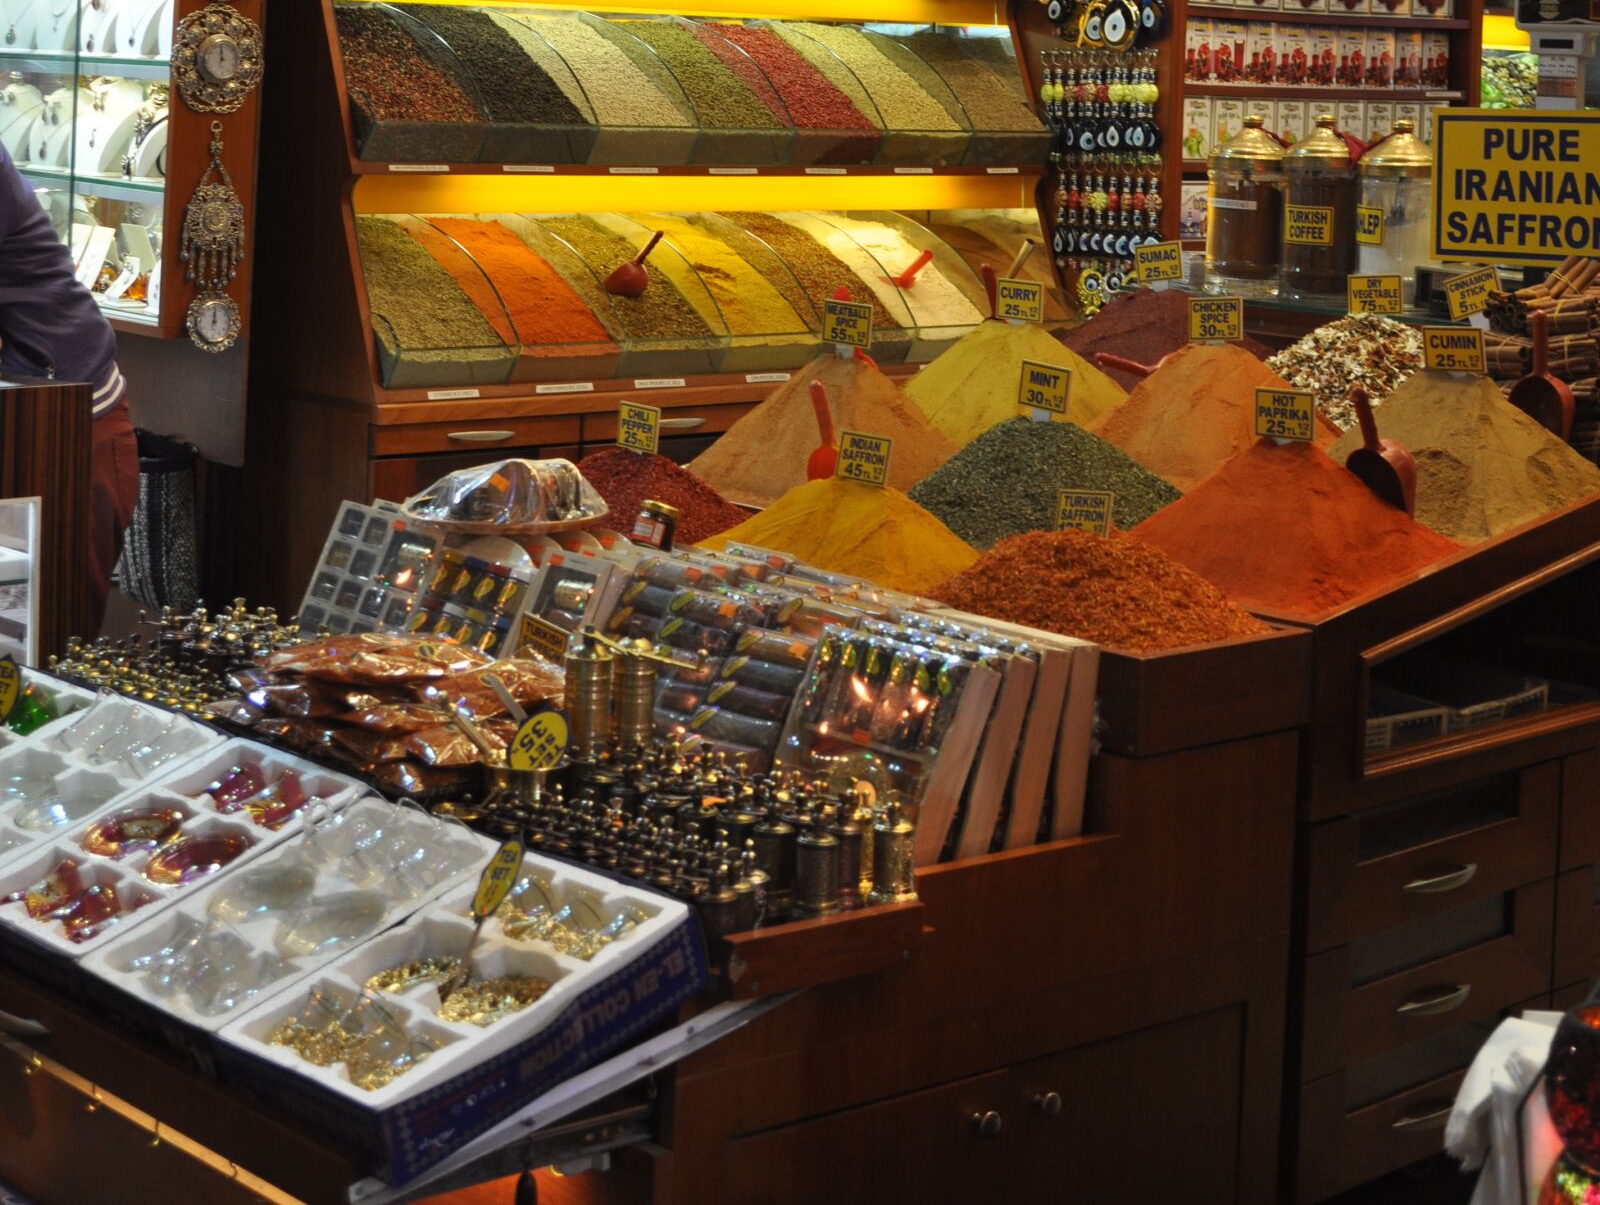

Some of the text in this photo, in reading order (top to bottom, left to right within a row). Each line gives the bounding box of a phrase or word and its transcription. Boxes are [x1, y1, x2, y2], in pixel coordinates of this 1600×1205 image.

[1483, 128, 1580, 162] PURE
[1288, 209, 1328, 225] TURKISH
[1289, 224, 1325, 240] COFFEE
[1139, 249, 1177, 264] SUMAC
[1367, 279, 1382, 288] DRY
[1449, 271, 1493, 292] CINNAMON
[1000, 286, 1038, 302] CURRY
[1353, 289, 1398, 299] VEGETABLE
[1460, 285, 1487, 300] STICK
[827, 304, 868, 320] MEATBALL
[1192, 302, 1237, 313] CHICKEN
[835, 316, 858, 329] SPICE
[1200, 313, 1230, 323] SPICE
[1430, 334, 1477, 350] CUMIN
[1029, 370, 1060, 389] MINT
[1272, 394, 1297, 407] HOT
[1258, 405, 1310, 421] PAPRIKA
[850, 437, 881, 453] INDIAN
[842, 448, 885, 467] SAFFRON
